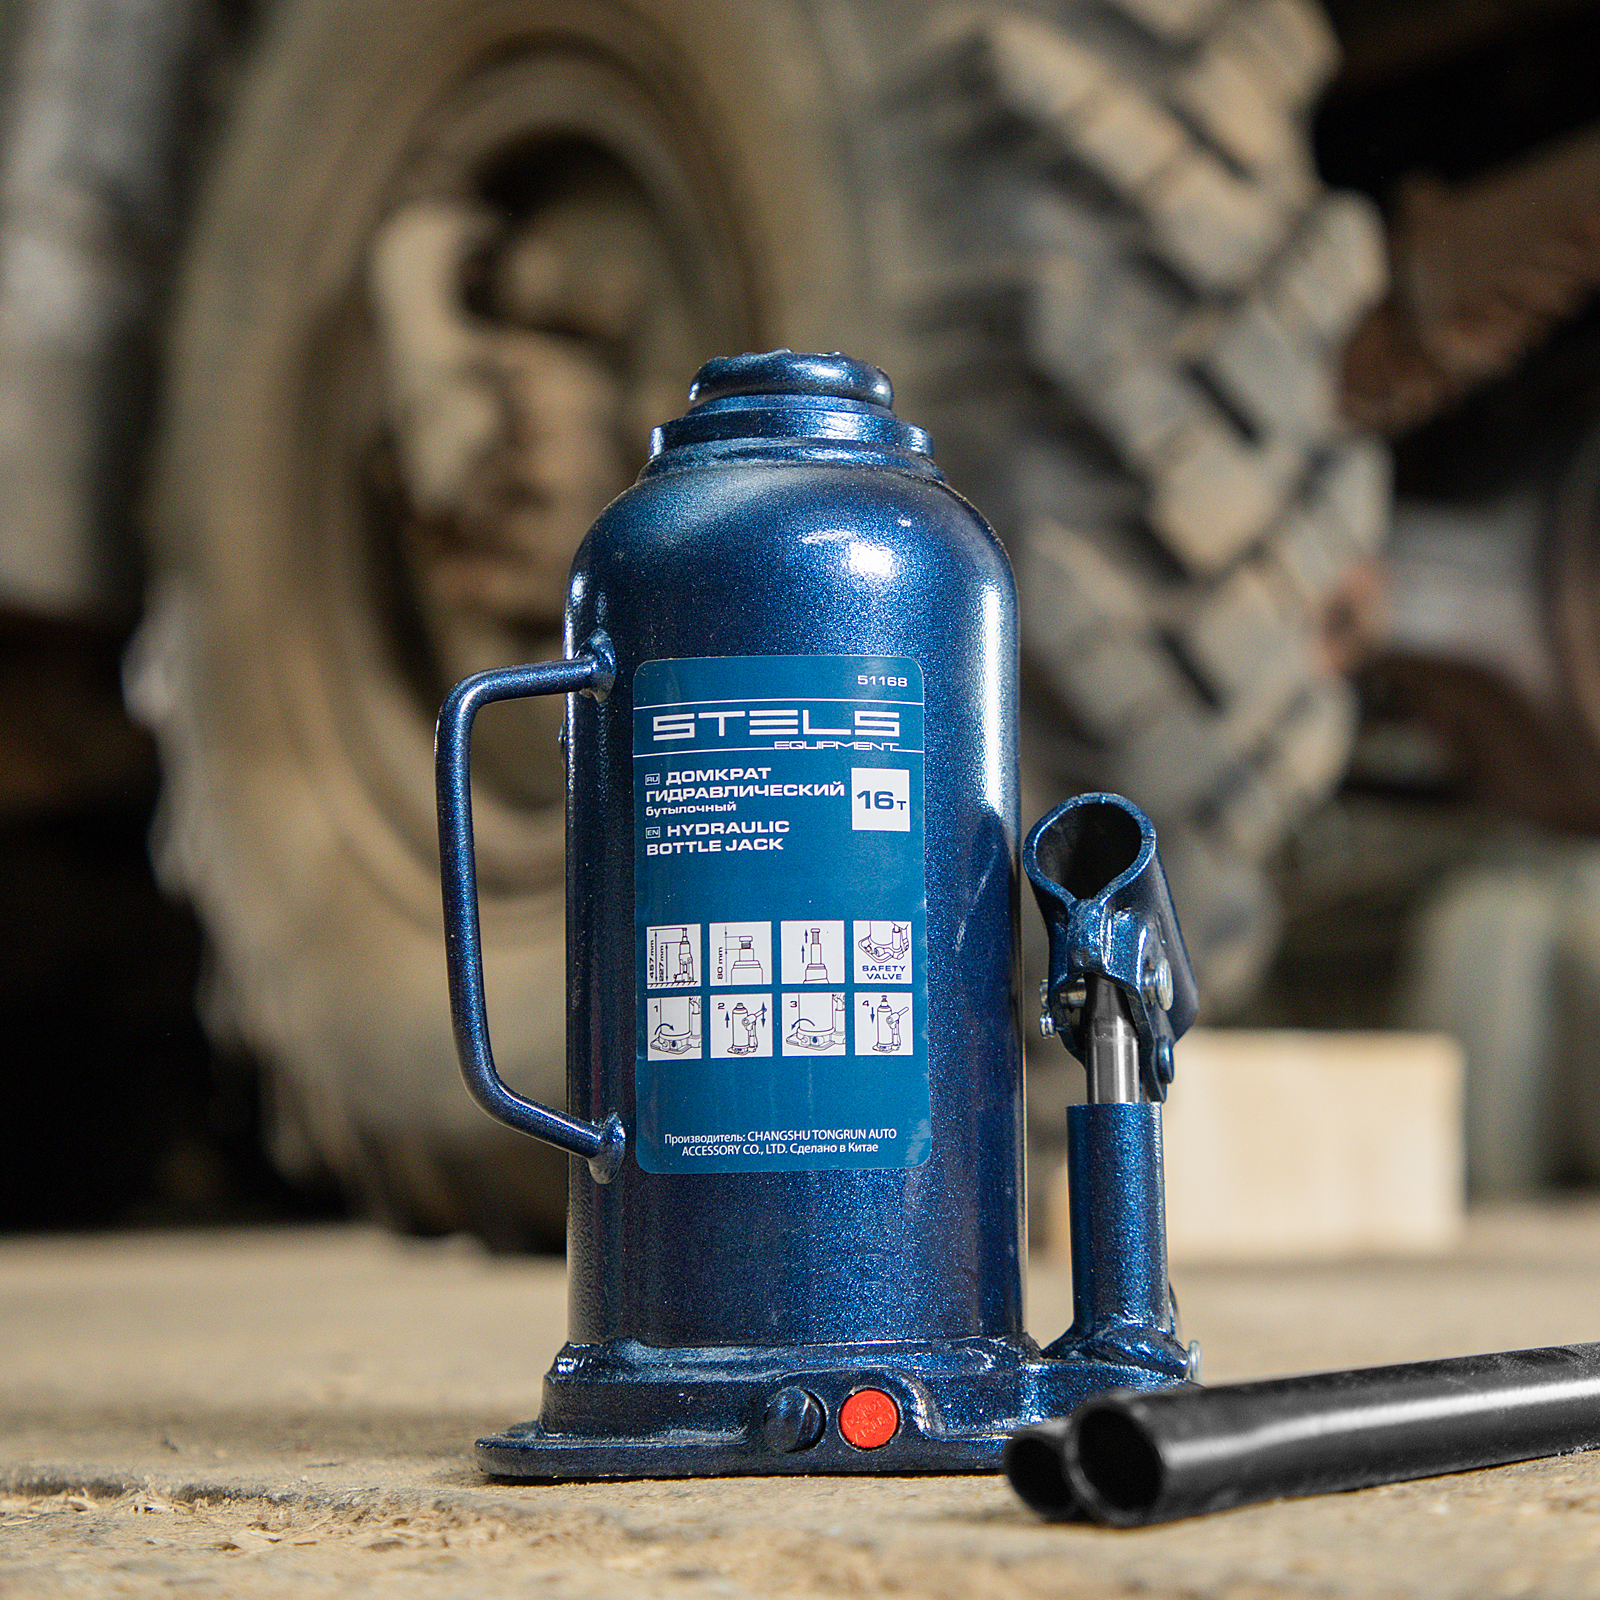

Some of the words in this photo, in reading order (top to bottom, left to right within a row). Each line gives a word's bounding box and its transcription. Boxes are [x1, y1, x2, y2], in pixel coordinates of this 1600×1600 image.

[857, 675, 908, 687] 51168
[653, 709, 900, 741] STELS
[774, 740, 899, 751] EQUIPMENT
[666, 767, 772, 786] ДОМКРАТ
[646, 781, 845, 803] ГИДРАВЛИЧЕСКИЙ
[645, 801, 737, 818] бутылочный
[667, 820, 790, 837] HYDRAULIC
[646, 840, 722, 856] BOTTLE
[725, 838, 784, 851] JACK
[718, 946, 723, 965] mm
[717, 966, 723, 980] 80
[717, 1002, 725, 1010] 2
[789, 1000, 798, 1008] 3
[664, 1133, 746, 1147] Производитель:
[747, 1130, 811, 1142] CHANGSHU
[812, 1129, 866, 1141] TONGRUN
[868, 1128, 897, 1139] AUTO
[682, 1144, 741, 1157] ACCESSORY
[765, 1143, 788, 1155] LTD.
[789, 1143, 838, 1156] Сделано
[839, 1145, 846, 1153] в
[848, 1142, 879, 1153] Китае
